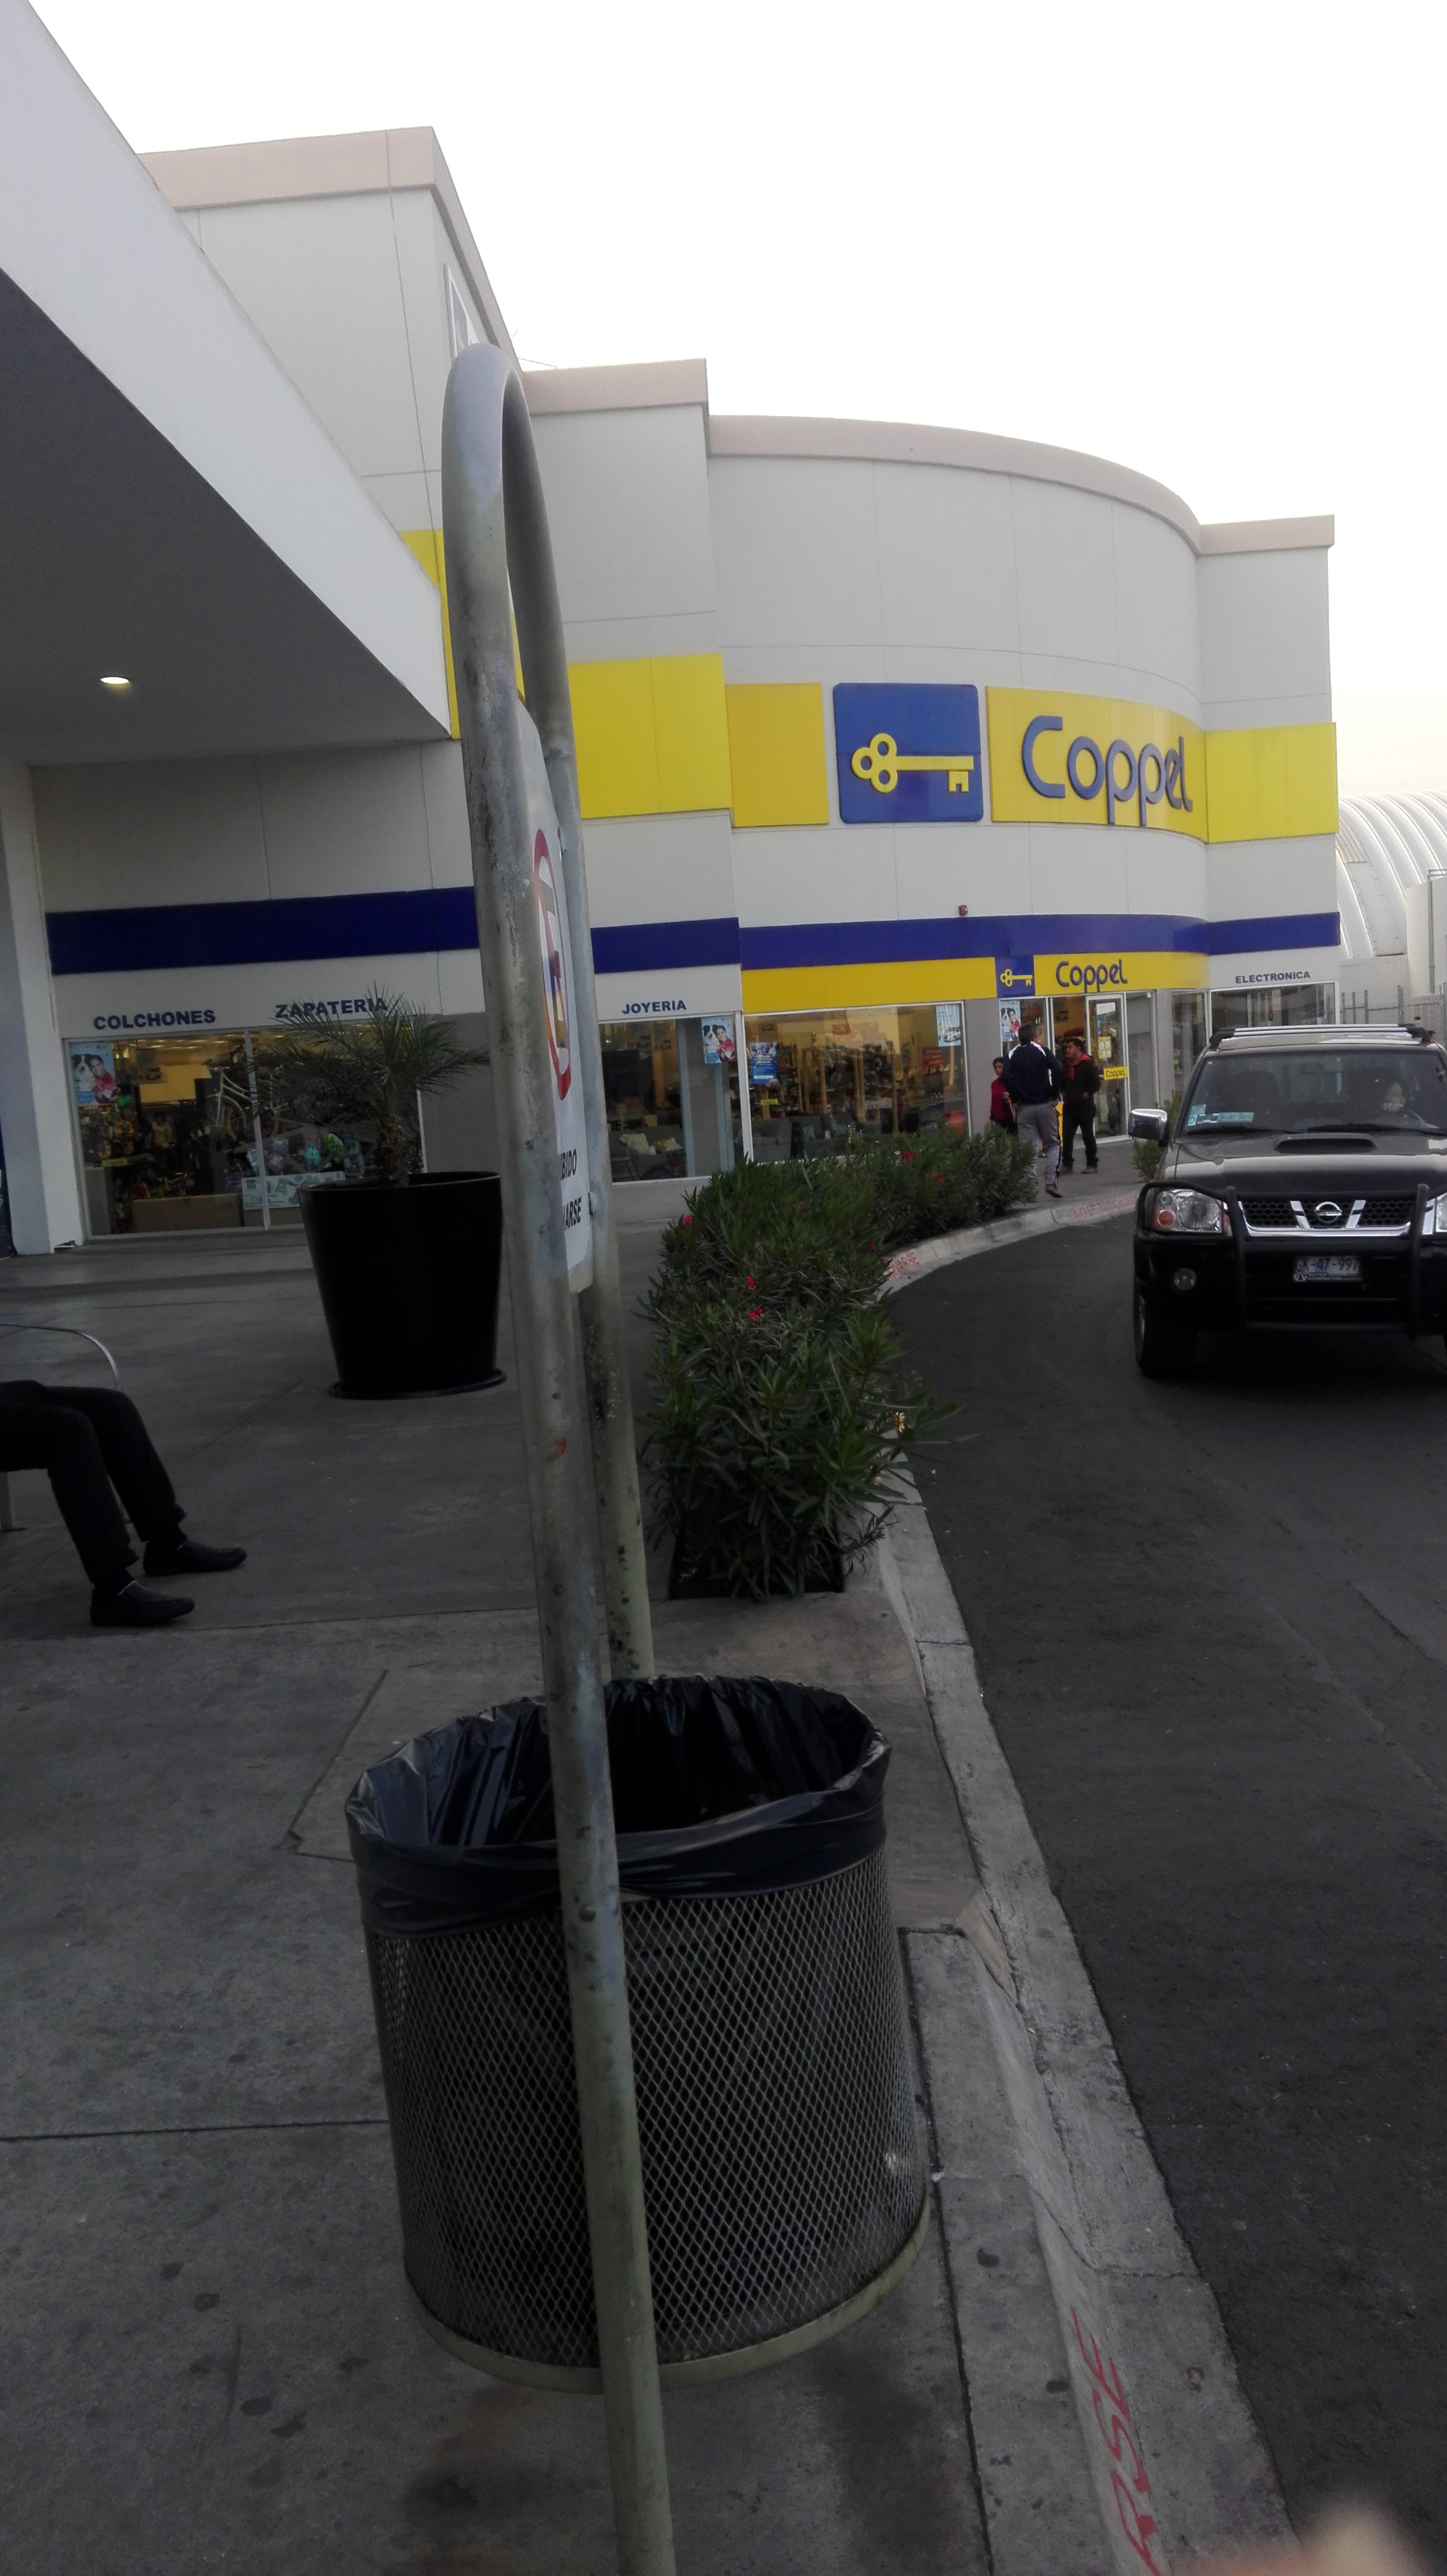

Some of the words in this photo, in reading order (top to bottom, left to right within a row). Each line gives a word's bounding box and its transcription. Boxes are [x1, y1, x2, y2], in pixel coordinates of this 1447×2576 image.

[1022, 715, 1193, 827] Coppel
[1056, 959, 1128, 993] Coppel
[1235, 971, 1311, 984] ELECTRONICA
[275, 998, 388, 1019] ZAPATERIA
[621, 999, 686, 1014] JOYERIA
[94, 1009, 216, 1030] COLCHONES
[1106, 1069, 1126, 1079] Coppel
